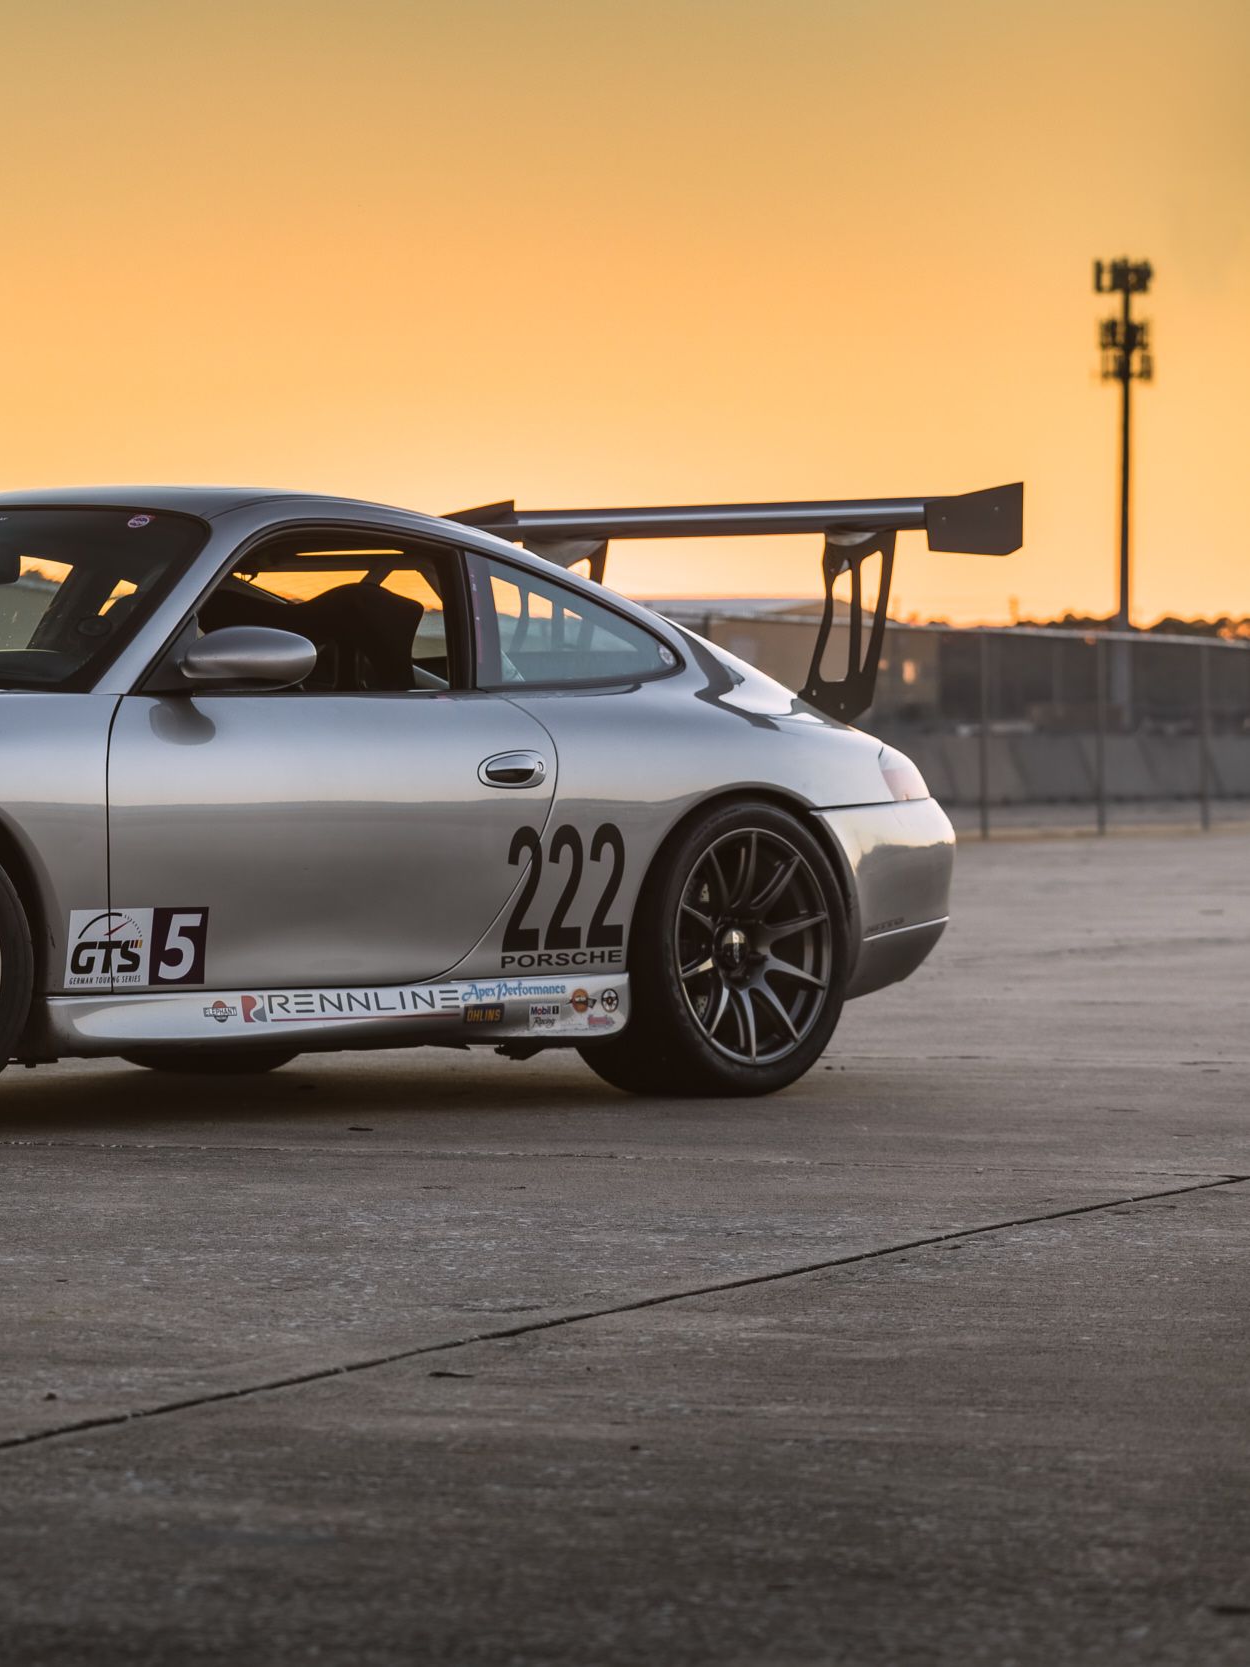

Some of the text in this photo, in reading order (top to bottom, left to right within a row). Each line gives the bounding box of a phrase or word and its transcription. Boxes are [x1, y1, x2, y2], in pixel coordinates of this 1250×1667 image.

[501, 823, 625, 952] 222
[70, 940, 141, 974] GTS
[157, 913, 202, 980] 5
[501, 950, 623, 968] PORSCHE
[69, 975, 141, 985] GERMAN TOURNG SERIES
[268, 990, 460, 1014] RENNLINE
[462, 981, 566, 1002] Apex Performance
[531, 1006, 551, 1015] Mobil
